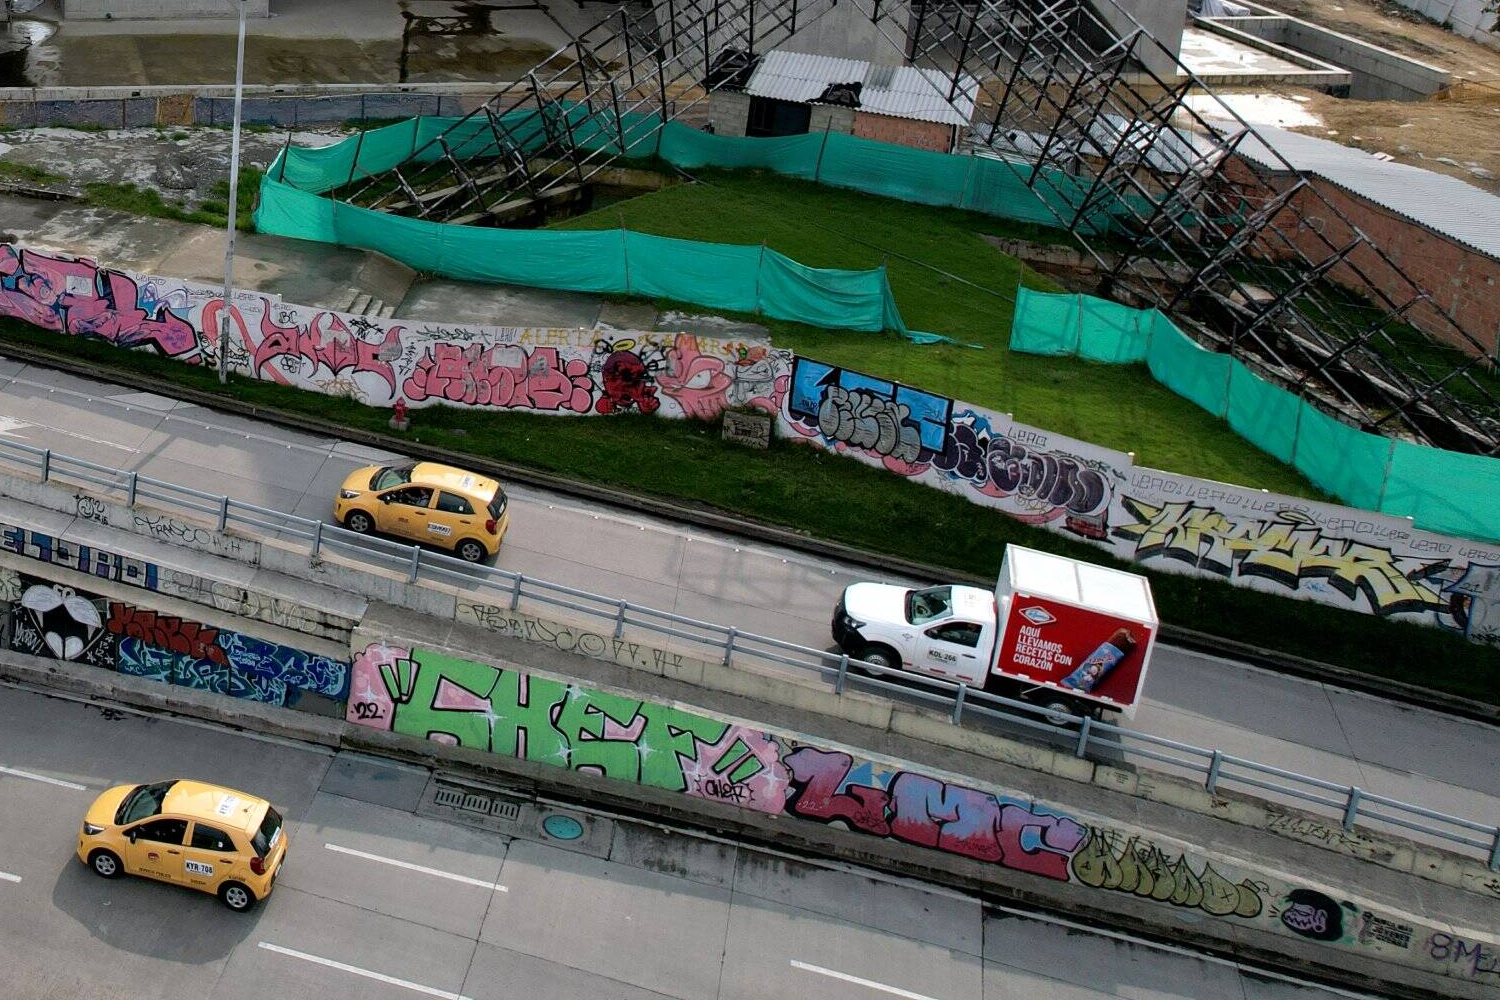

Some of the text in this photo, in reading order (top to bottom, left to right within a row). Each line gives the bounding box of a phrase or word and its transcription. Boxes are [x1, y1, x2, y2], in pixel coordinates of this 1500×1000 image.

[0, 524, 41, 561] EL
[51, 537, 148, 585] ORO
[1019, 625, 1041, 638] AQUÍ
[1017, 635, 1063, 653] LLEVAMOS
[1012, 653, 1054, 671] CORAZÓN
[1015, 643, 1053, 661] RECETAS
[1054, 653, 1072, 666] CON
